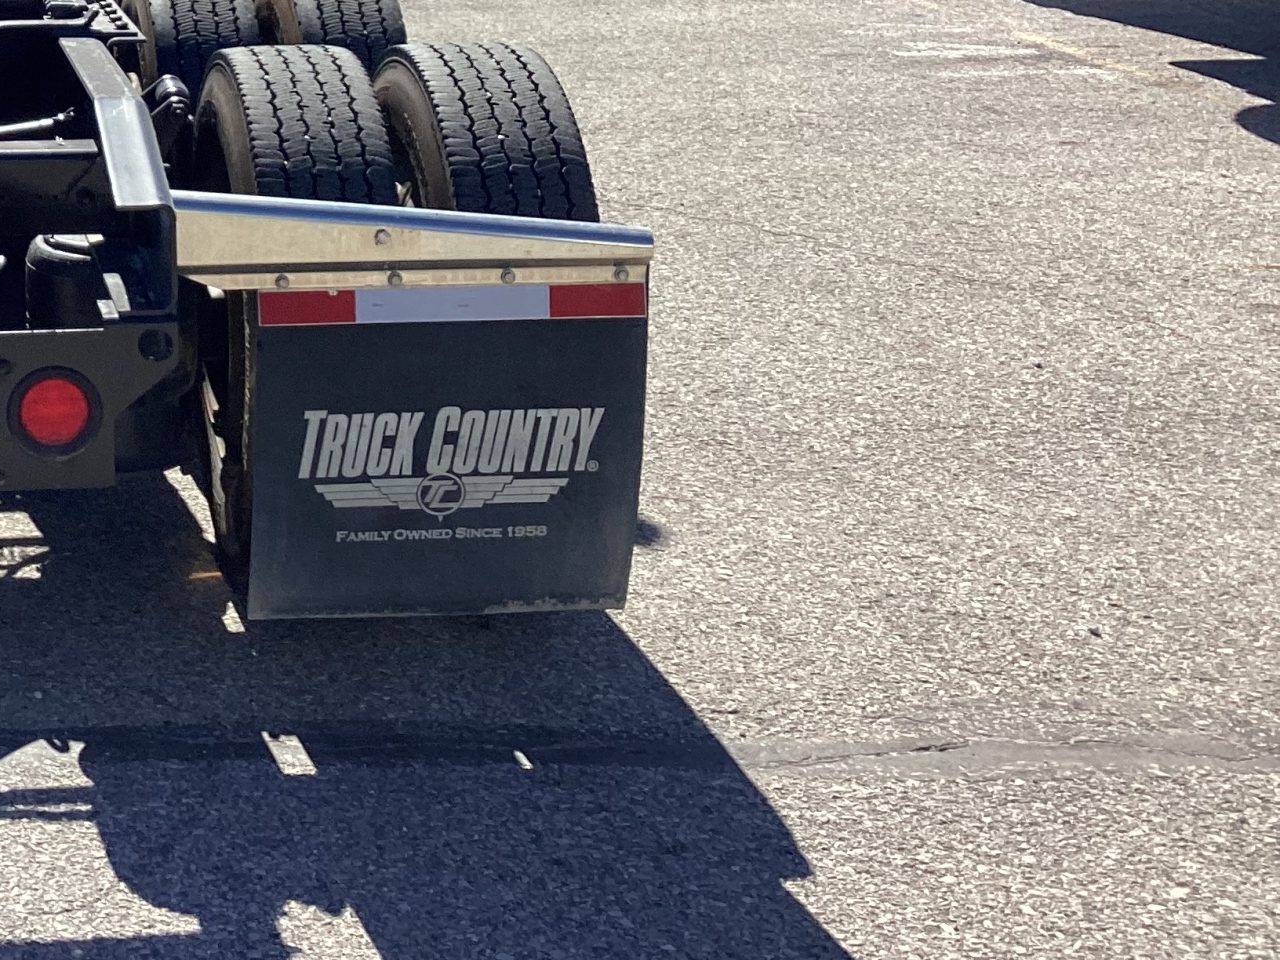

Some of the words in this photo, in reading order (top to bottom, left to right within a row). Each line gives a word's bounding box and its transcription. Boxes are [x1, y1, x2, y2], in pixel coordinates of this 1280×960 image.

[298, 410, 424, 479] TRUCK
[426, 406, 606, 474] COUNTRY
[336, 530, 392, 543] FAMILY
[393, 528, 453, 540] OWNED
[455, 527, 503, 539] SINCE
[507, 525, 548, 537] 1958
